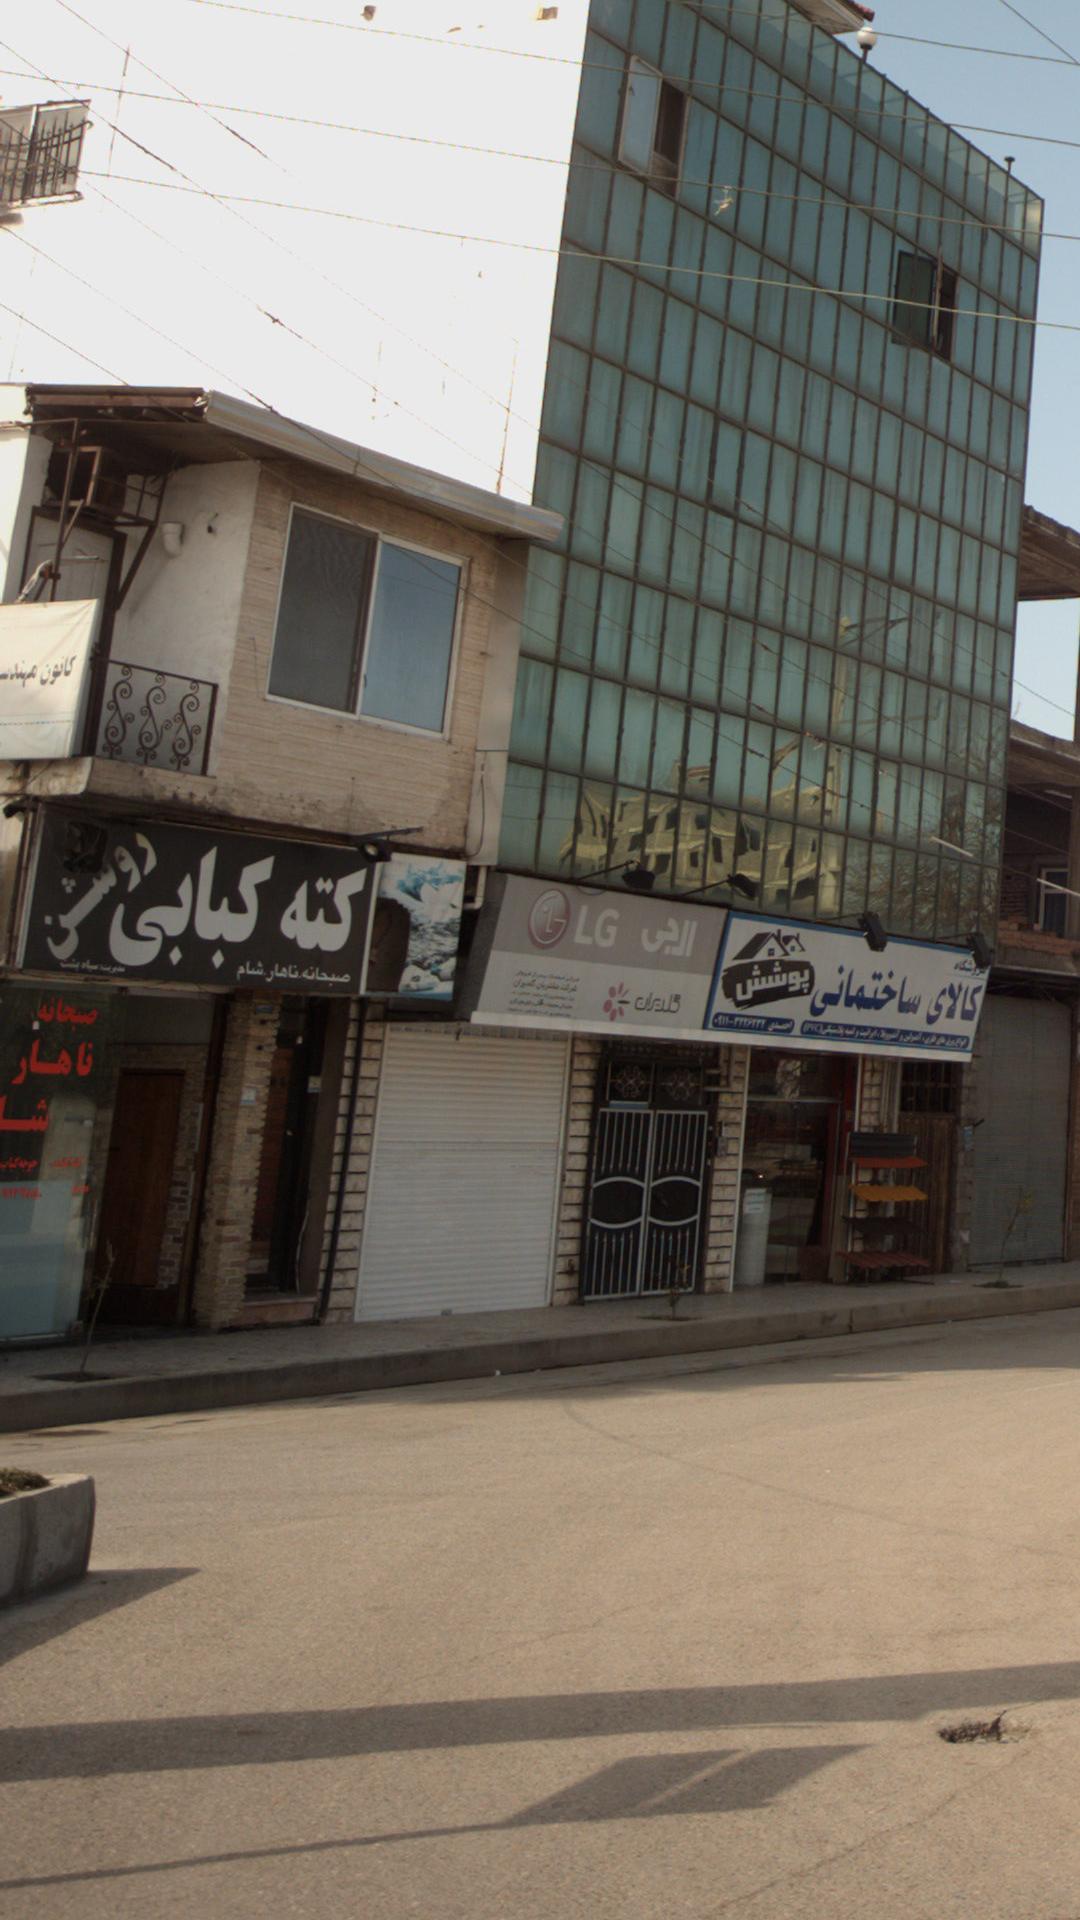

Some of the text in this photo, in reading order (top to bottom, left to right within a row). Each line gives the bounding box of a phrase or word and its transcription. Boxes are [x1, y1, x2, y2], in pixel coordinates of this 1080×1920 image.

[0, 655, 77, 688] کانون مهندس
[108, 846, 367, 969] کته کبابی
[575, 904, 620, 948] LG
[235, 960, 264, 981] شام
[736, 960, 810, 1001] پوشش
[37, 995, 98, 1031] صبحانه
[810, 965, 984, 1025] کالای ساختمانی
[11, 1039, 94, 1085] ناهار
[0, 1094, 49, 1132] شا
